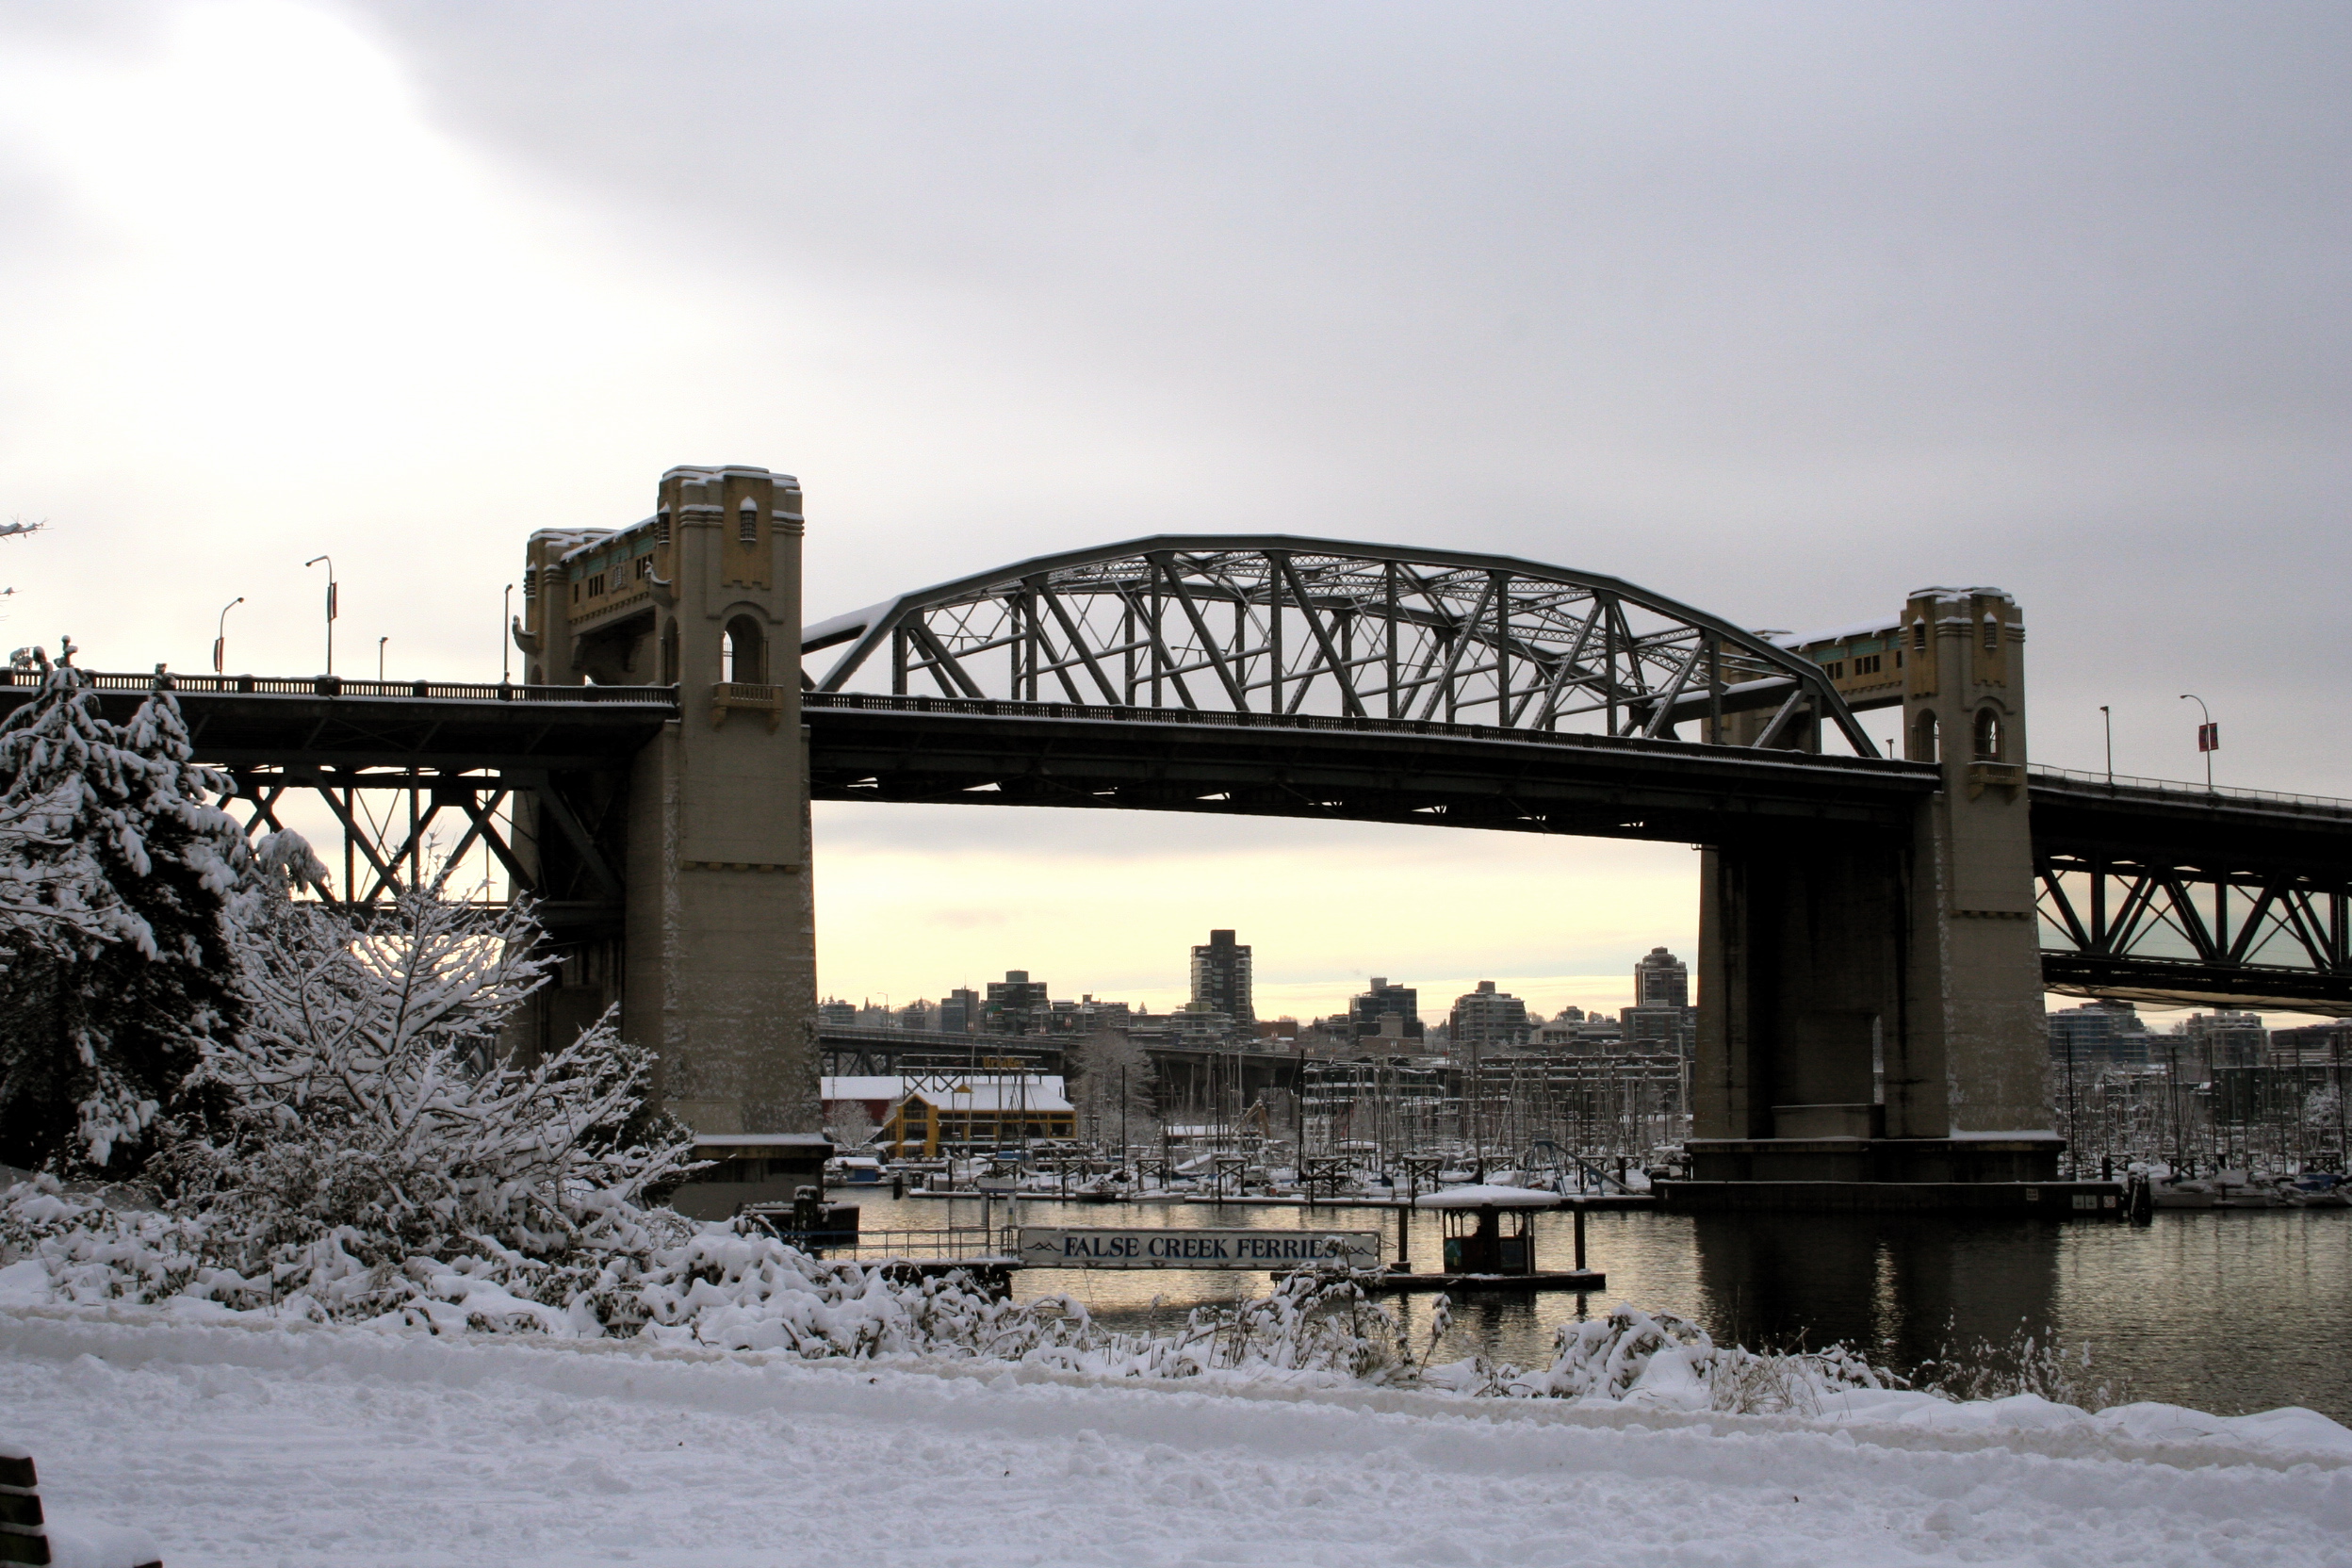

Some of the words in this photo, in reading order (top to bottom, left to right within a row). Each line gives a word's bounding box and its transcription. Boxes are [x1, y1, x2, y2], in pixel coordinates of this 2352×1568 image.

[1063, 1236, 1140, 1257] FALSE
[1148, 1237, 1229, 1258] CREEK
[1236, 1238, 1338, 1259] FERRIES
